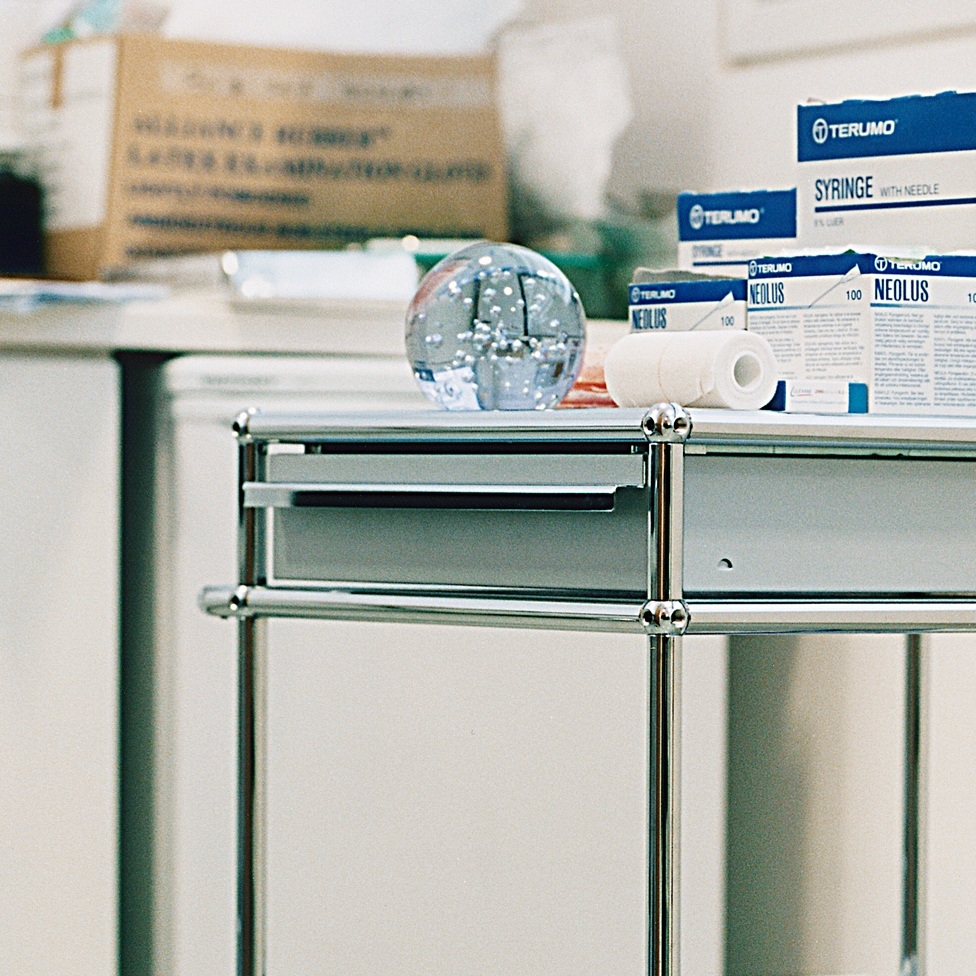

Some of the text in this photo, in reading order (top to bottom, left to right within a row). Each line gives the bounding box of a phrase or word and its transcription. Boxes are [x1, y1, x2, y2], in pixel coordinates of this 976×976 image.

[829, 120, 895, 138] TERUMO
[815, 176, 939, 201] SYRINGE WITH NEEDLE
[703, 209, 759, 224] TERUMO
[756, 263, 792, 273] TERUMO
[750, 282, 862, 304] NEOLUS 100
[874, 279, 929, 302] NEOLUS
[632, 308, 734, 330] NEOLUS 100
